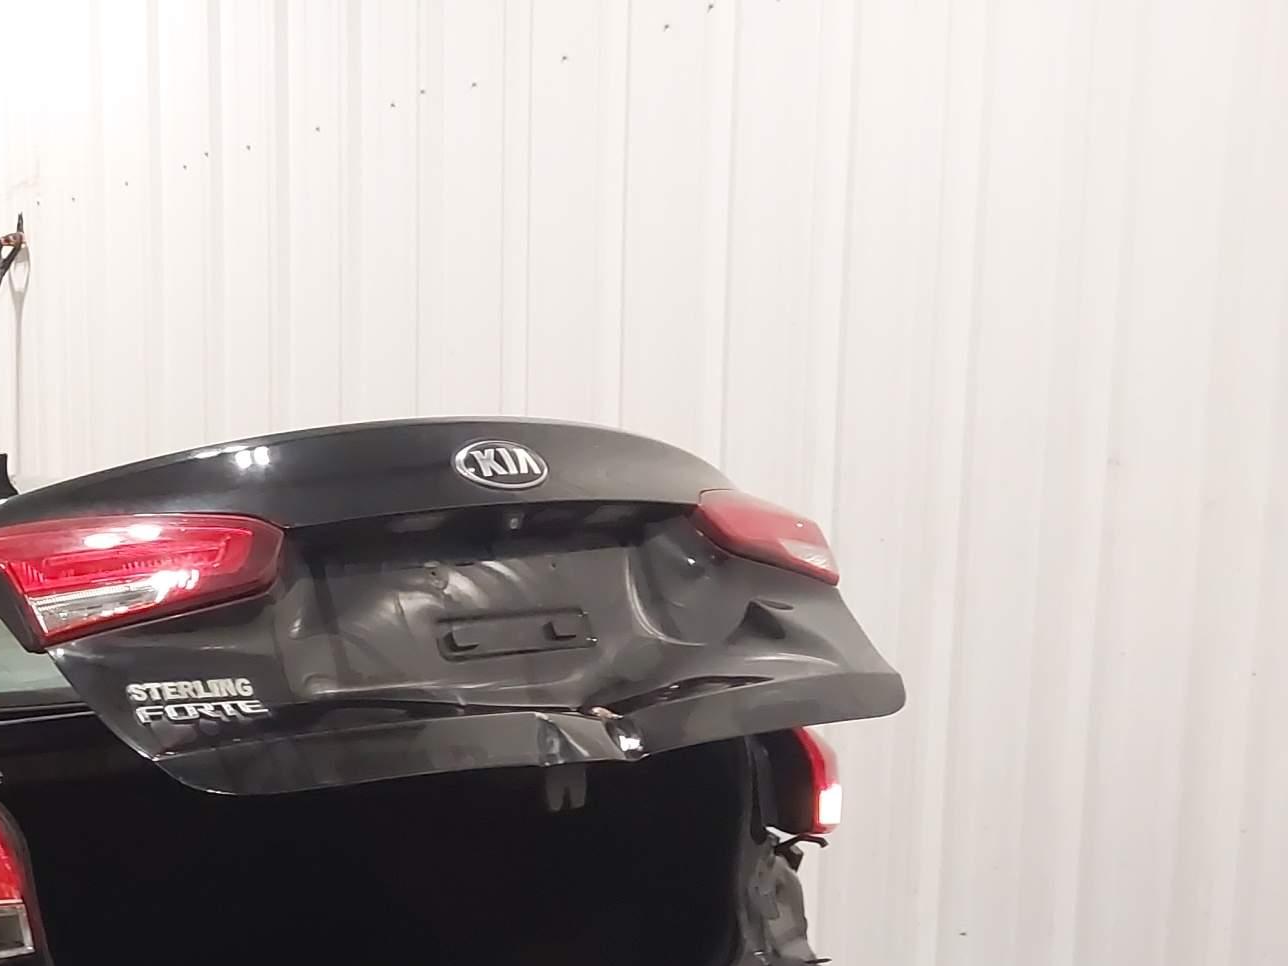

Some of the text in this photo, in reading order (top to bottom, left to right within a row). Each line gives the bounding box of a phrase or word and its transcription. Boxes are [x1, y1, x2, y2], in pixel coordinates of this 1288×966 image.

[469, 447, 542, 477] KIA
[126, 678, 254, 702] STERLING
[135, 700, 269, 724] FORTE
